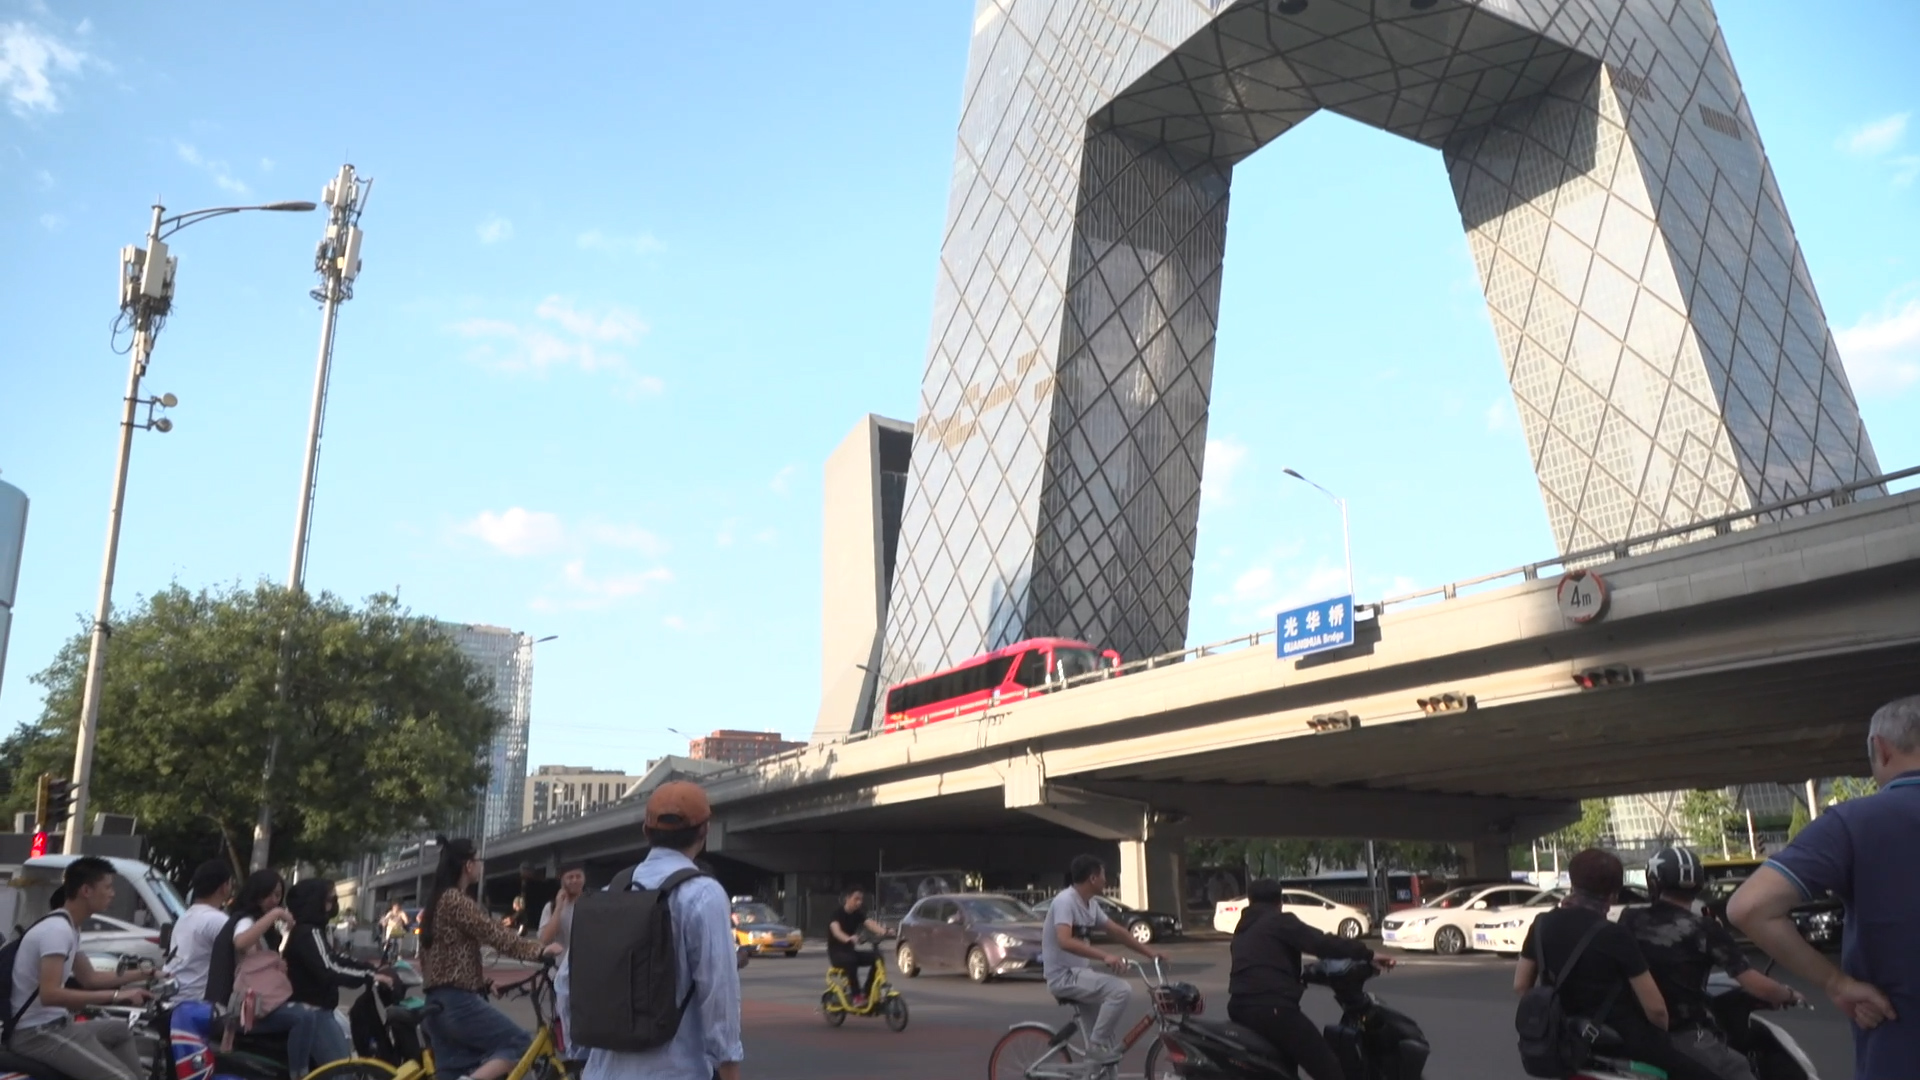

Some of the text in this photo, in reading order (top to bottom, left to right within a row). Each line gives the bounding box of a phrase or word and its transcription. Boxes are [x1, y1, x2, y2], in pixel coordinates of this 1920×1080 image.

[1570, 585, 1592, 608] 4m
[1283, 603, 1344, 638] 光华桥
[1322, 631, 1345, 644] Bridge
